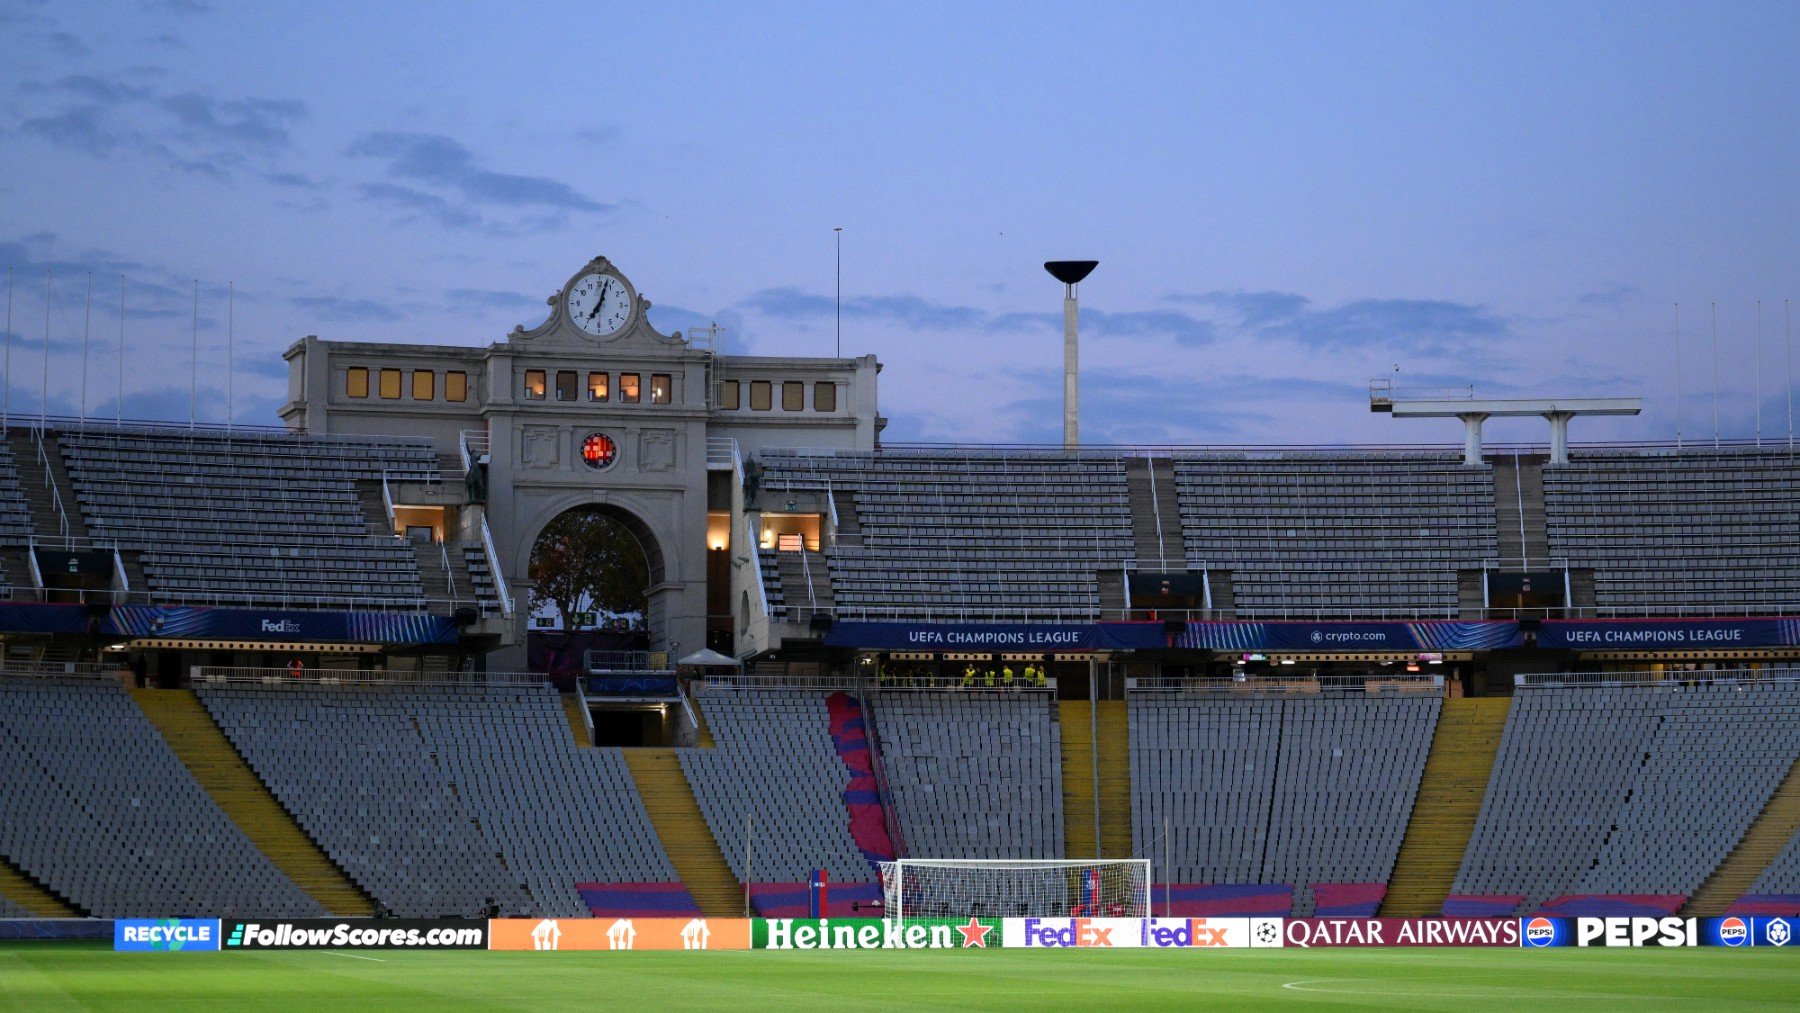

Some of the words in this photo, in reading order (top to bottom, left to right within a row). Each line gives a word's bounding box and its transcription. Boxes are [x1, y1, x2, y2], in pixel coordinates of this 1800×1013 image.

[261, 619, 300, 632] FedEx
[909, 631, 943, 643] UEFA
[947, 632, 1025, 643] CHAMPIONS
[1029, 631, 1079, 643] LEAGUE
[1325, 631, 1386, 642] crypto.com
[1566, 631, 1601, 642] UEFA
[1605, 630, 1685, 642] CHAMPIONS
[1690, 629, 1742, 641] LEAGUE
[124, 926, 210, 941] RECYCLE
[242, 923, 482, 946] FollowScores.com
[765, 918, 953, 949] Heineken
[1025, 918, 1113, 947] FedEx
[1141, 918, 1228, 947] FedEx
[1286, 920, 1385, 948] QATAR
[1396, 920, 1518, 944] AIRWAYS
[1577, 917, 1697, 947] PEPSI
[1721, 928, 1746, 936] PEPSI
